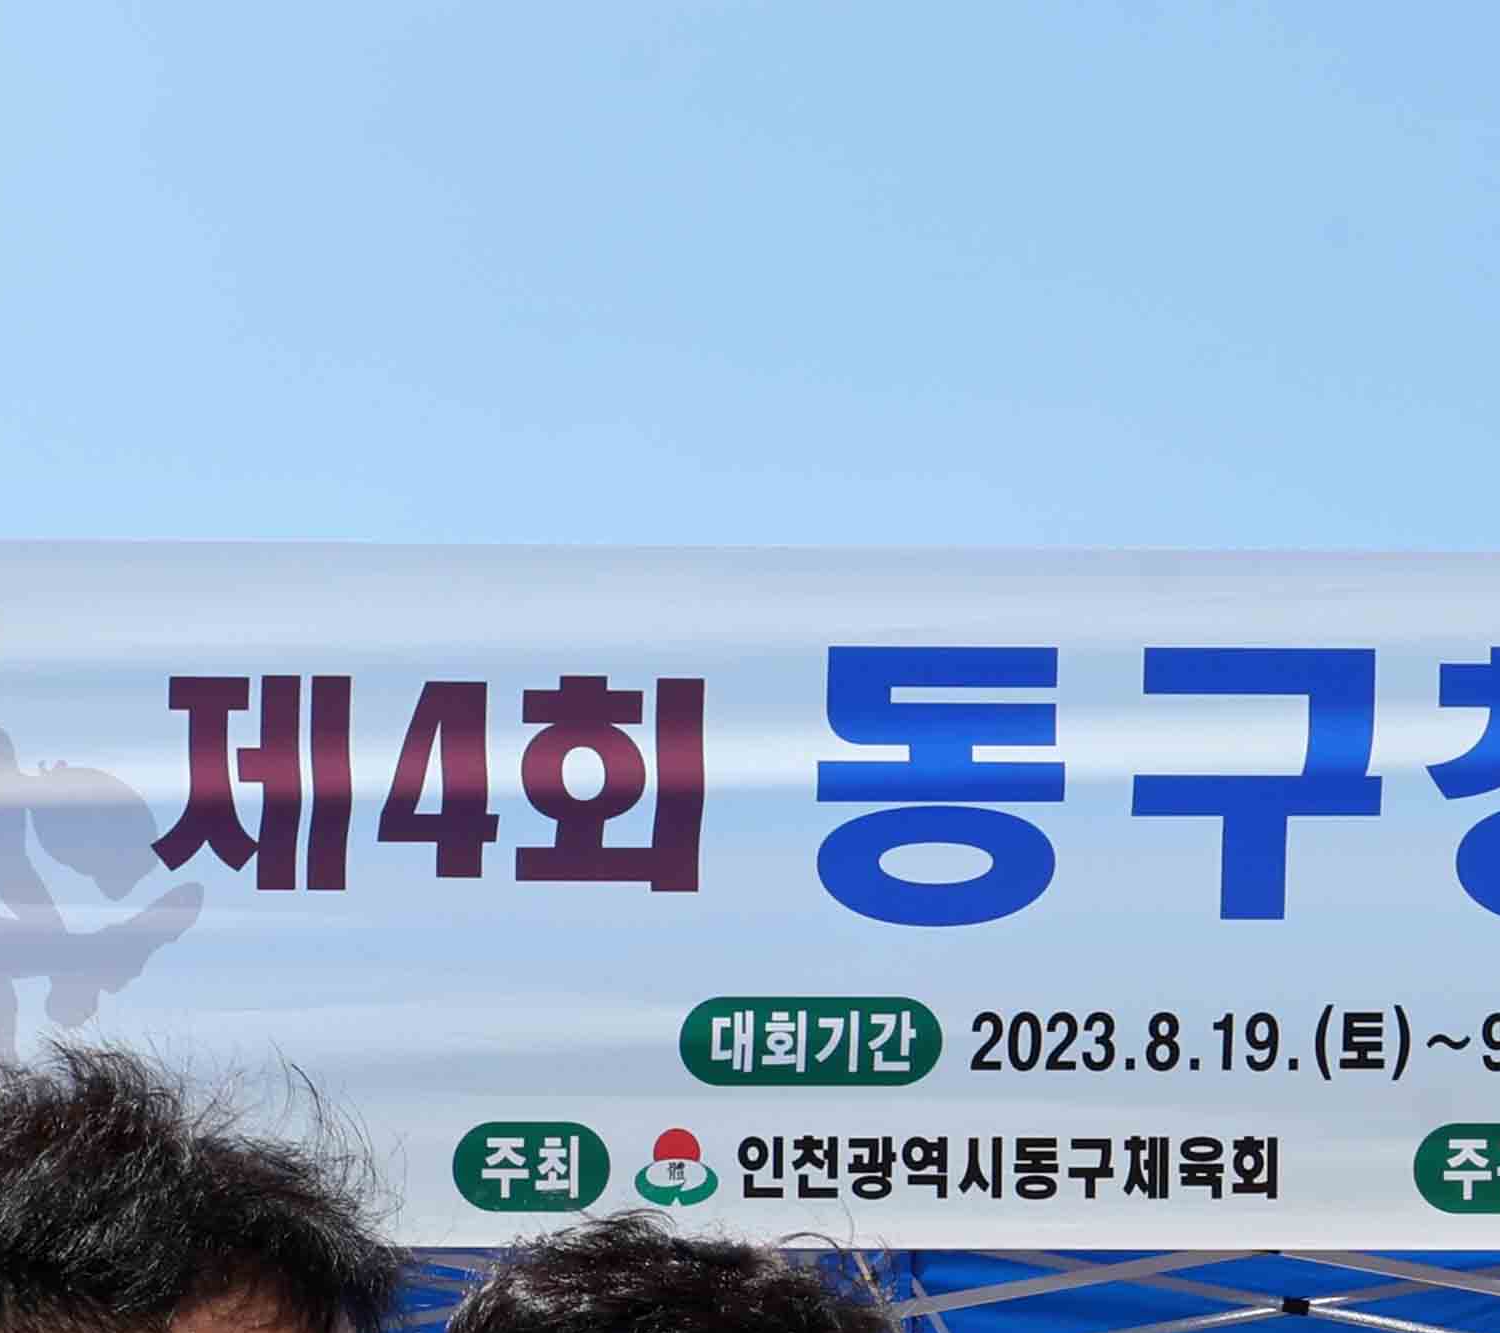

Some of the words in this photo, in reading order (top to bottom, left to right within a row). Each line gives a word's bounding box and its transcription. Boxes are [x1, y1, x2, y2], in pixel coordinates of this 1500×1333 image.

[151, 674, 705, 893] 제4회
[711, 1011, 917, 1073] 대회기간
[481, 1134, 580, 1198] 주최
[737, 1134, 1278, 1200] 인천광역시동구체육회
